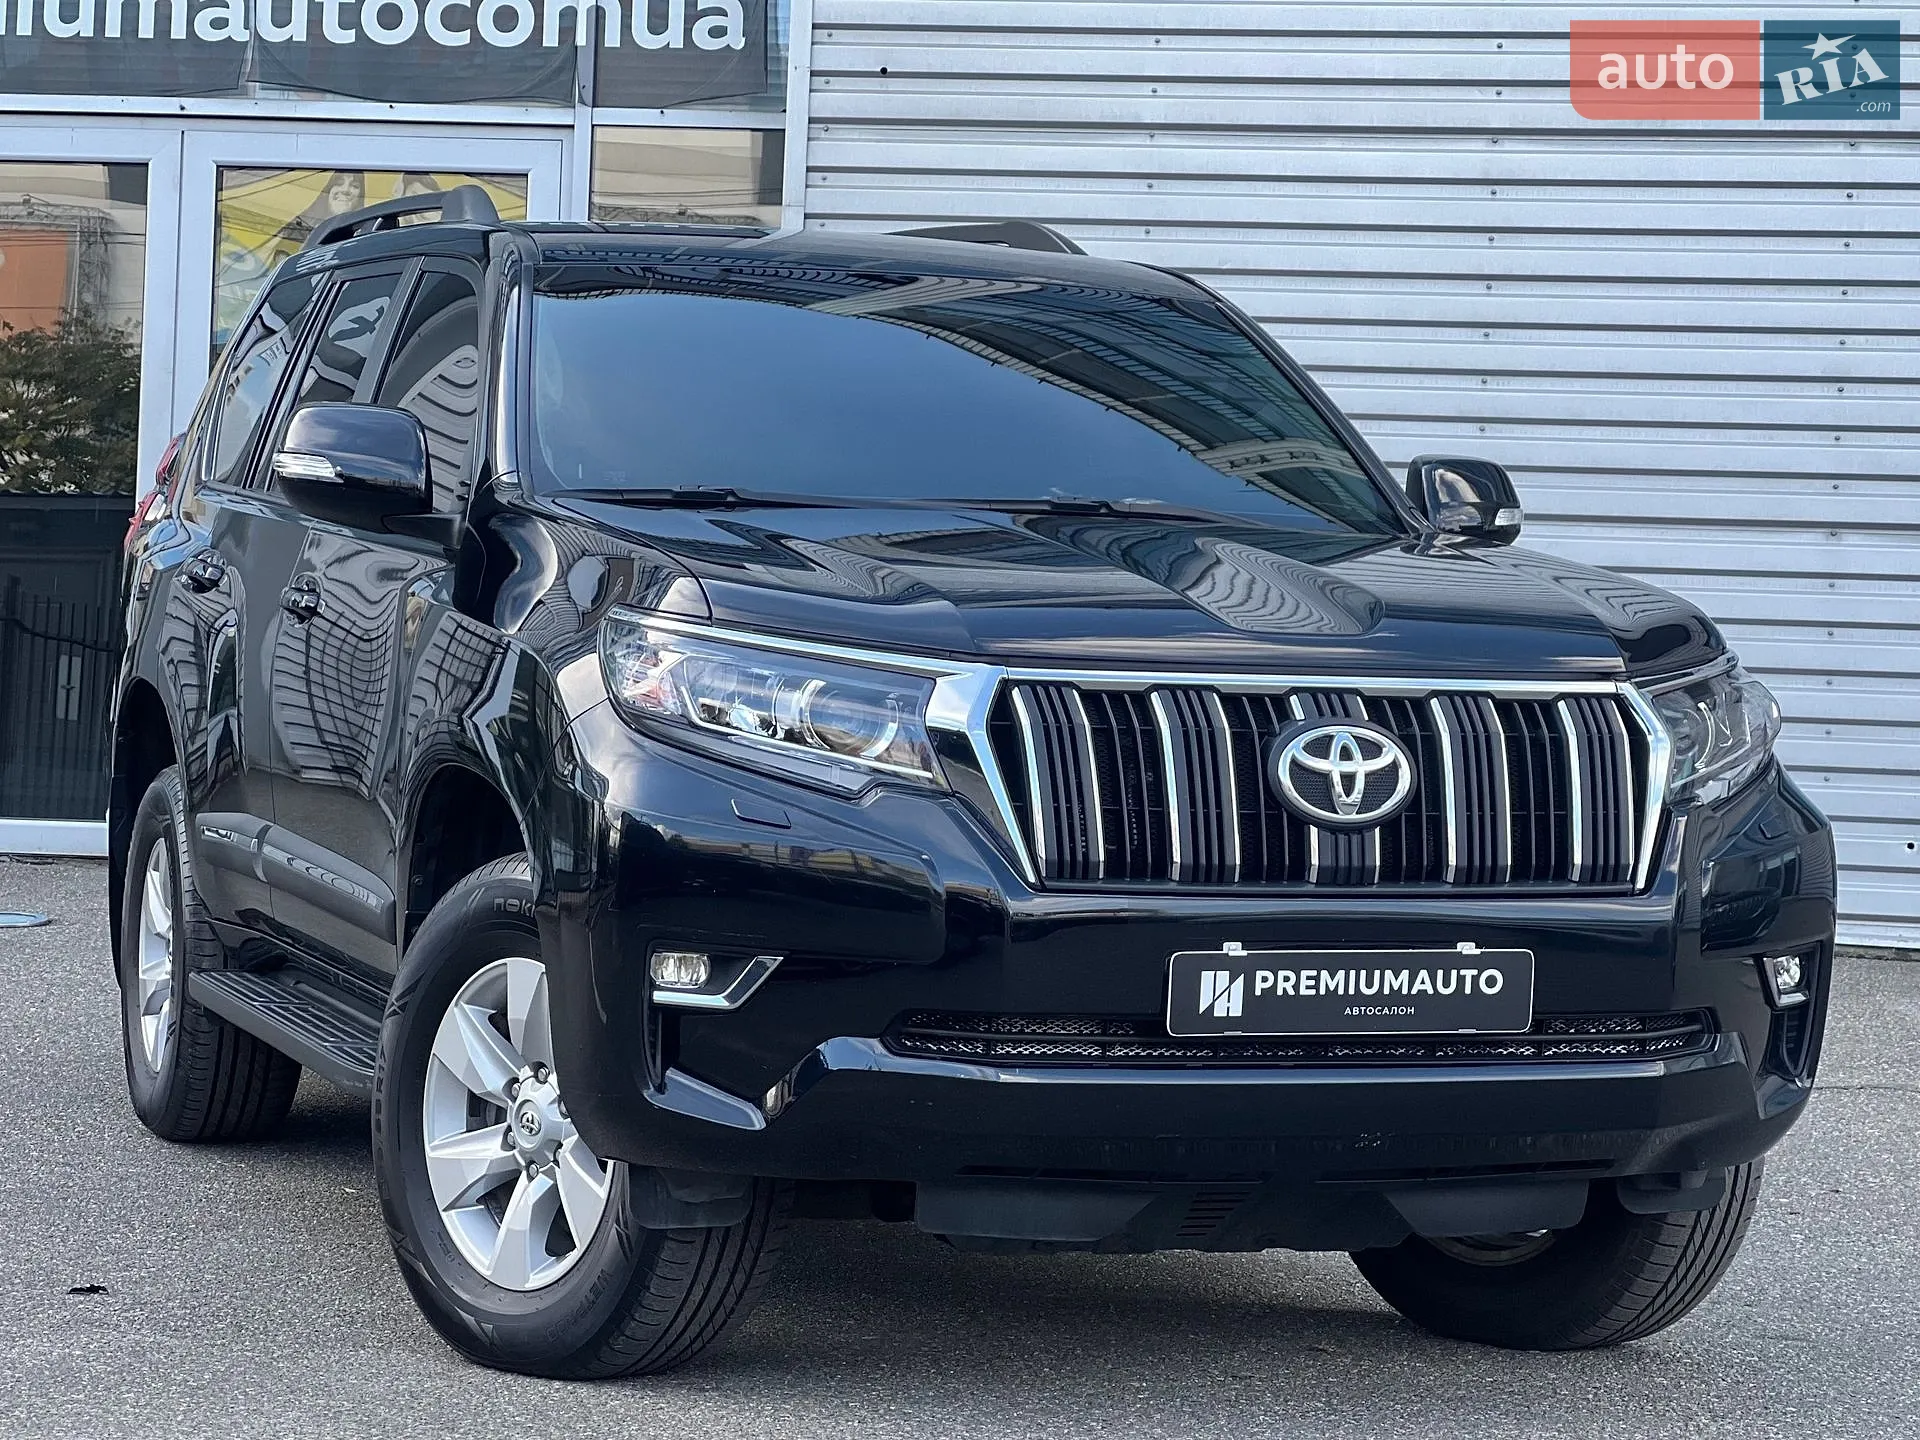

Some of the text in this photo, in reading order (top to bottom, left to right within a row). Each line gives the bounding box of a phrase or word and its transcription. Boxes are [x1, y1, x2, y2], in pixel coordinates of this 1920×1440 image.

[0, 0, 746, 50] iumautocomua
[1254, 968, 1504, 996] PREMIUMAUTO
[1343, 1005, 1416, 1017] АВТОСАЛОН
